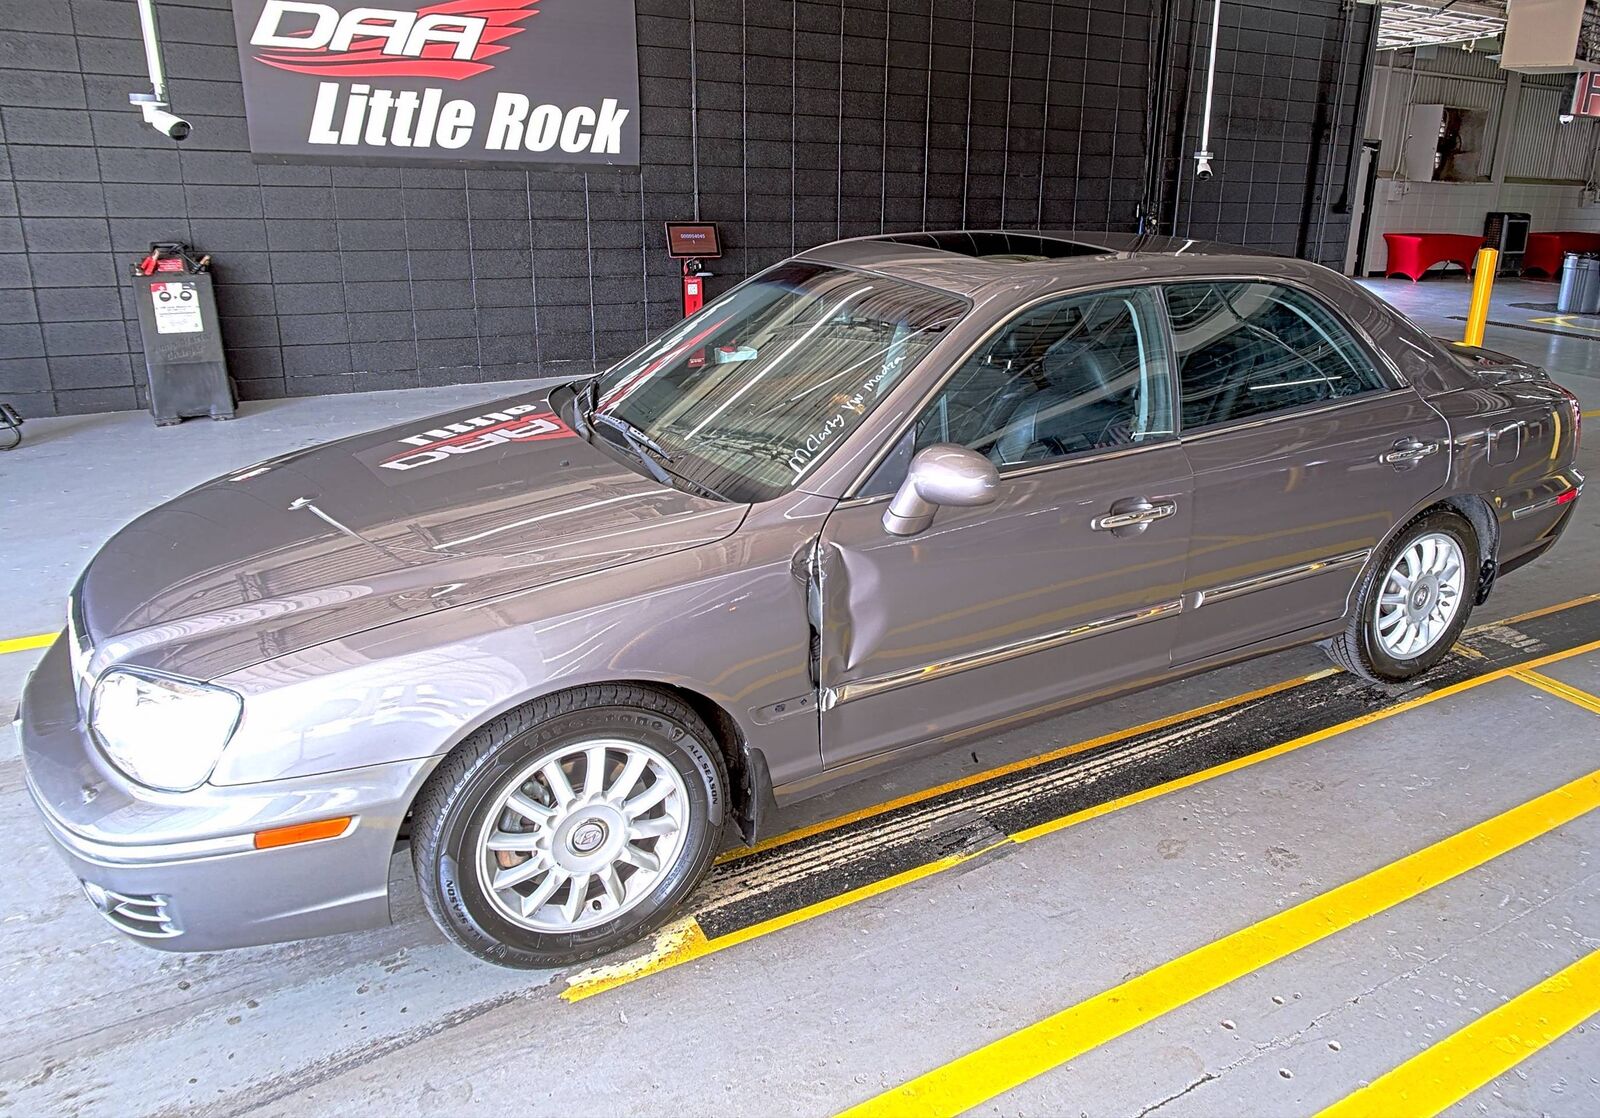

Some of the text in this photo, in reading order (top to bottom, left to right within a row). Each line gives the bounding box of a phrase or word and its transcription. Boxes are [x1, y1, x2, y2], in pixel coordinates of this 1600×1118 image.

[250, 0, 488, 60] DAA
[308, 82, 630, 154] Little Rock
[702, 763, 719, 806] SEASON
